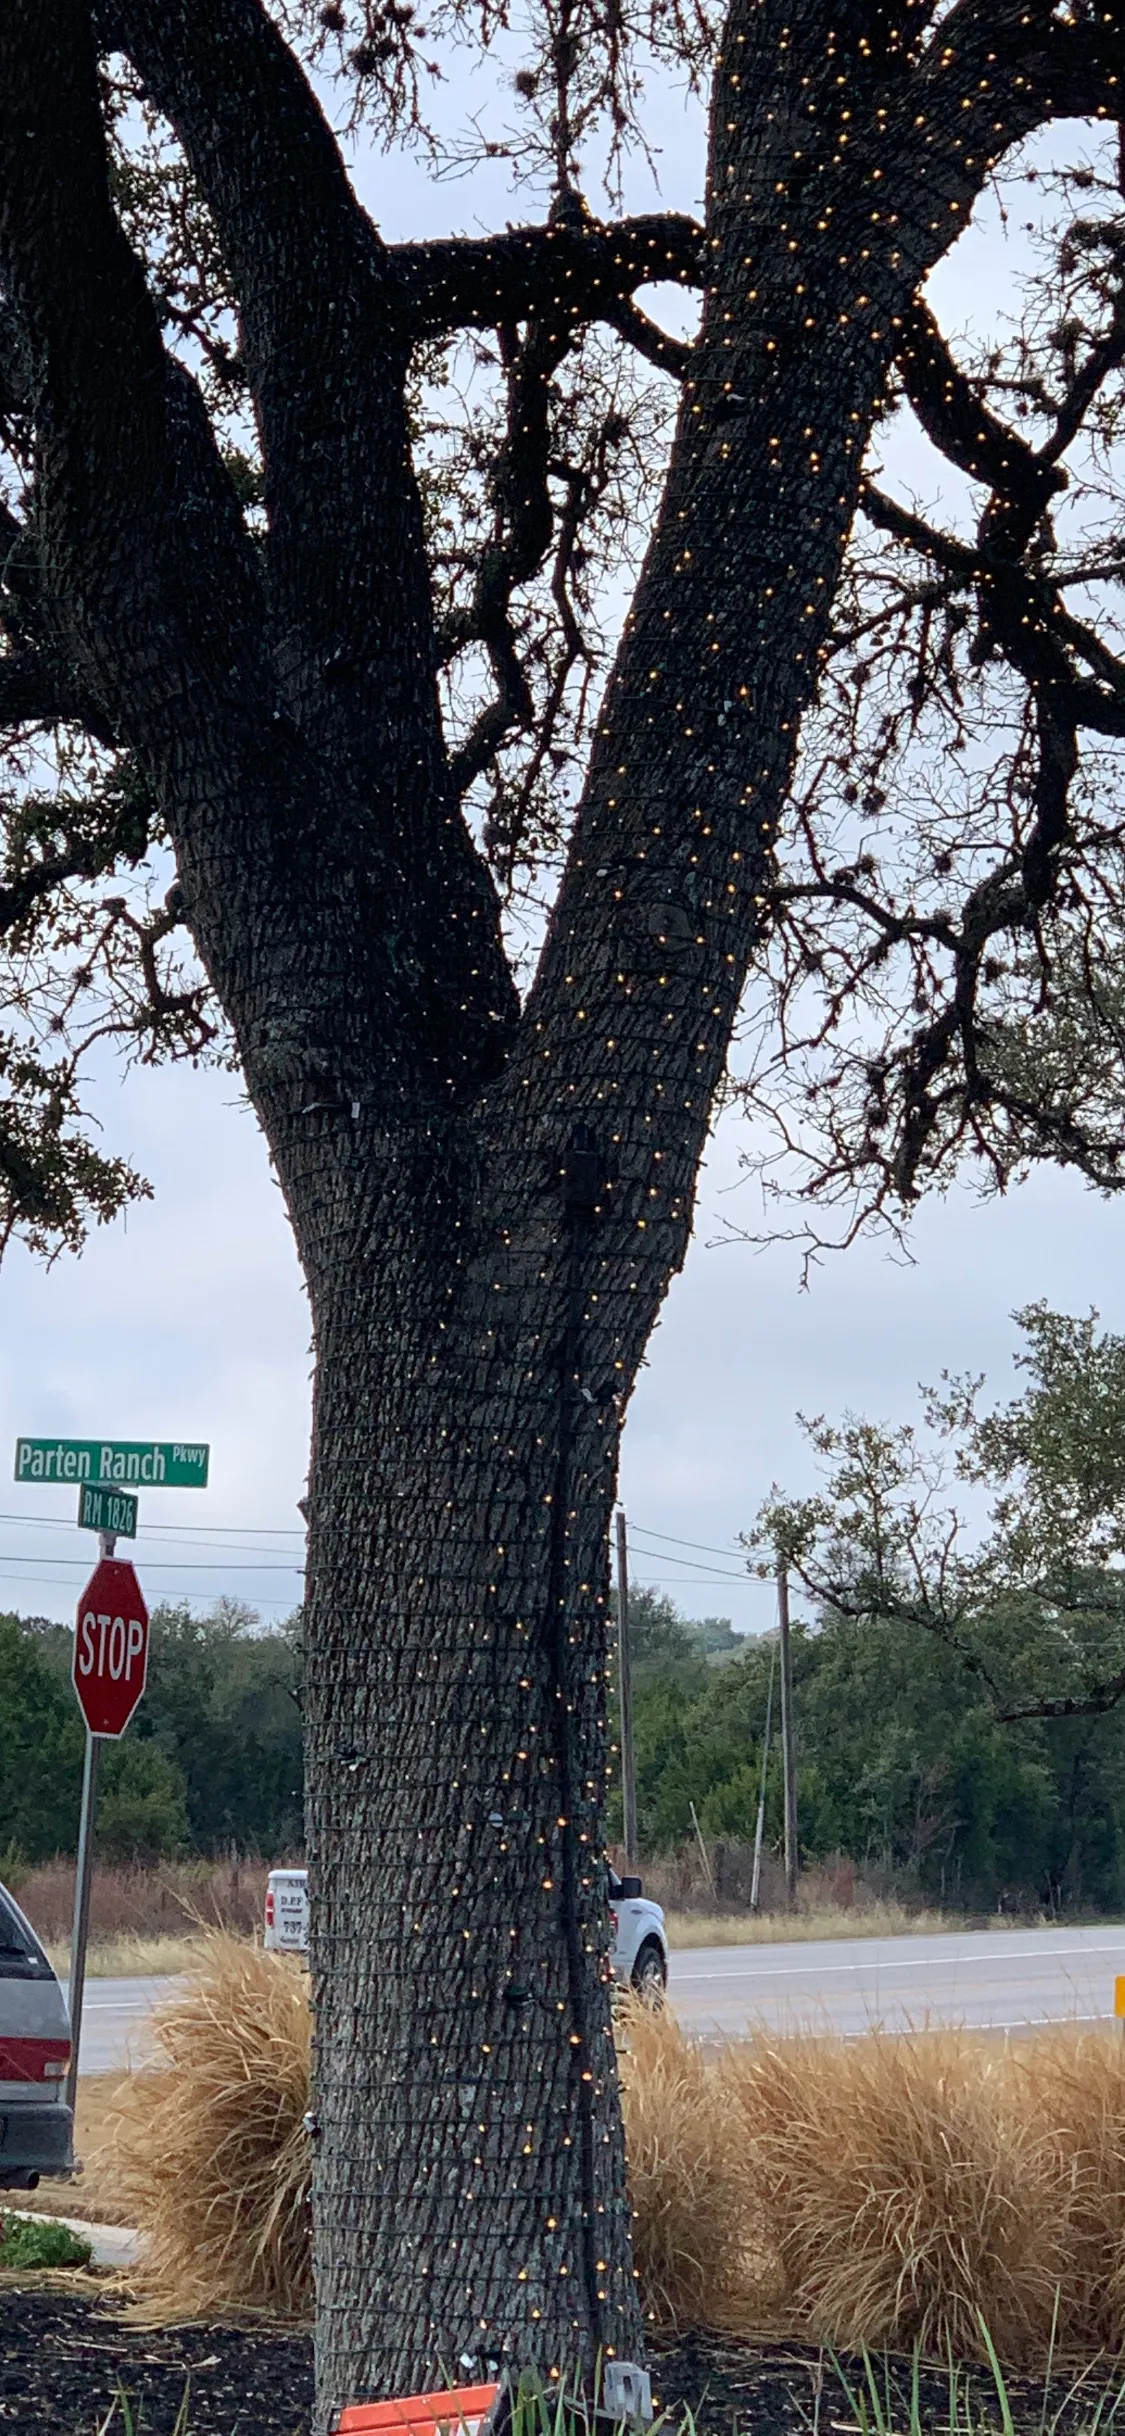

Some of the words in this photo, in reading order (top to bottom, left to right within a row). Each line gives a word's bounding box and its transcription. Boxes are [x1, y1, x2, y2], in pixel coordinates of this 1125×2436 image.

[18, 1444, 91, 1477] Parten
[99, 1446, 166, 1481] Ranch
[172, 1445, 206, 1467] Pkwy
[83, 1490, 102, 1524] RM
[107, 1496, 134, 1532] 1826
[79, 1611, 143, 1681] STOP
